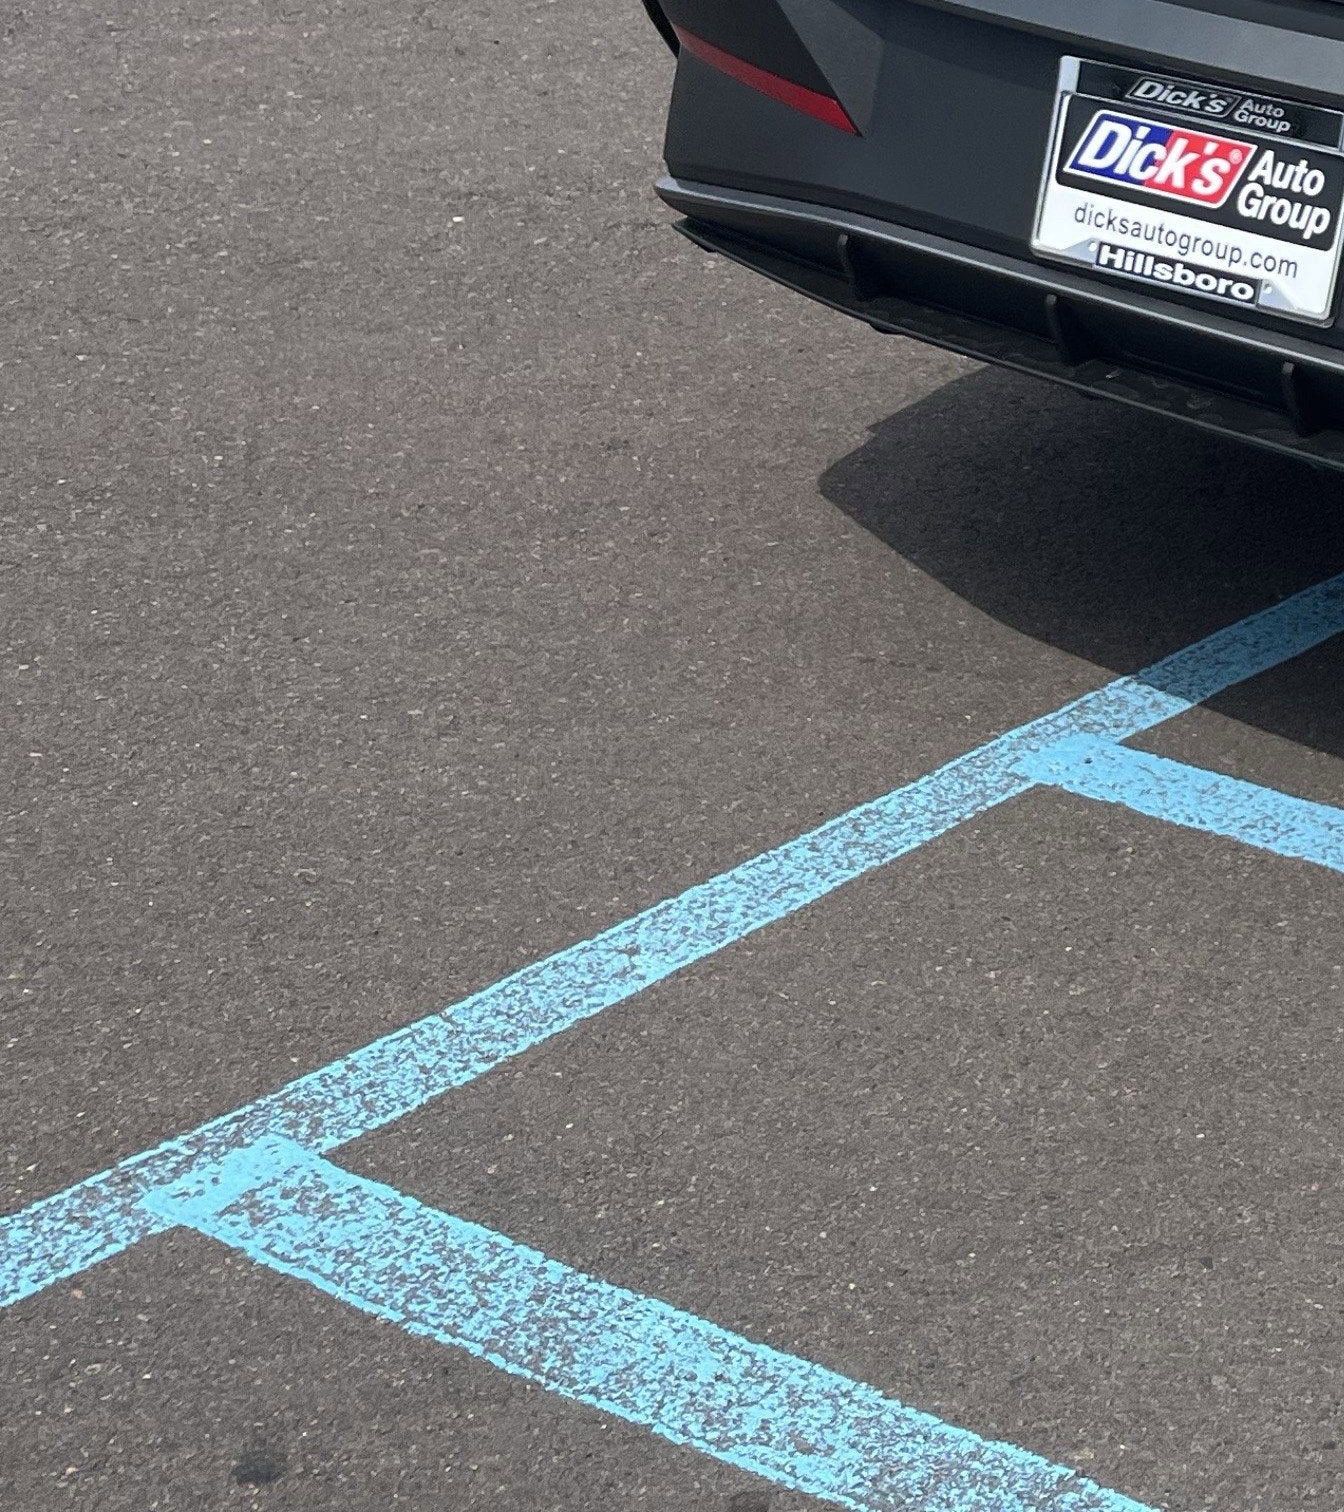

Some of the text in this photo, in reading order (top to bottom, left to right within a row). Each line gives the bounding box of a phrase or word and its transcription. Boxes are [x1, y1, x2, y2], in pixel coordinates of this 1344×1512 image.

[1131, 78, 1228, 114] Dick's
[1233, 110, 1291, 134] Group
[1242, 99, 1285, 118] Auto
[1077, 119, 1231, 198] Dick's
[1247, 149, 1326, 197] Auto
[1237, 183, 1332, 240] Group
[1073, 202, 1299, 279] dicksautogroup.com
[1096, 243, 1256, 302] Hillsboro
